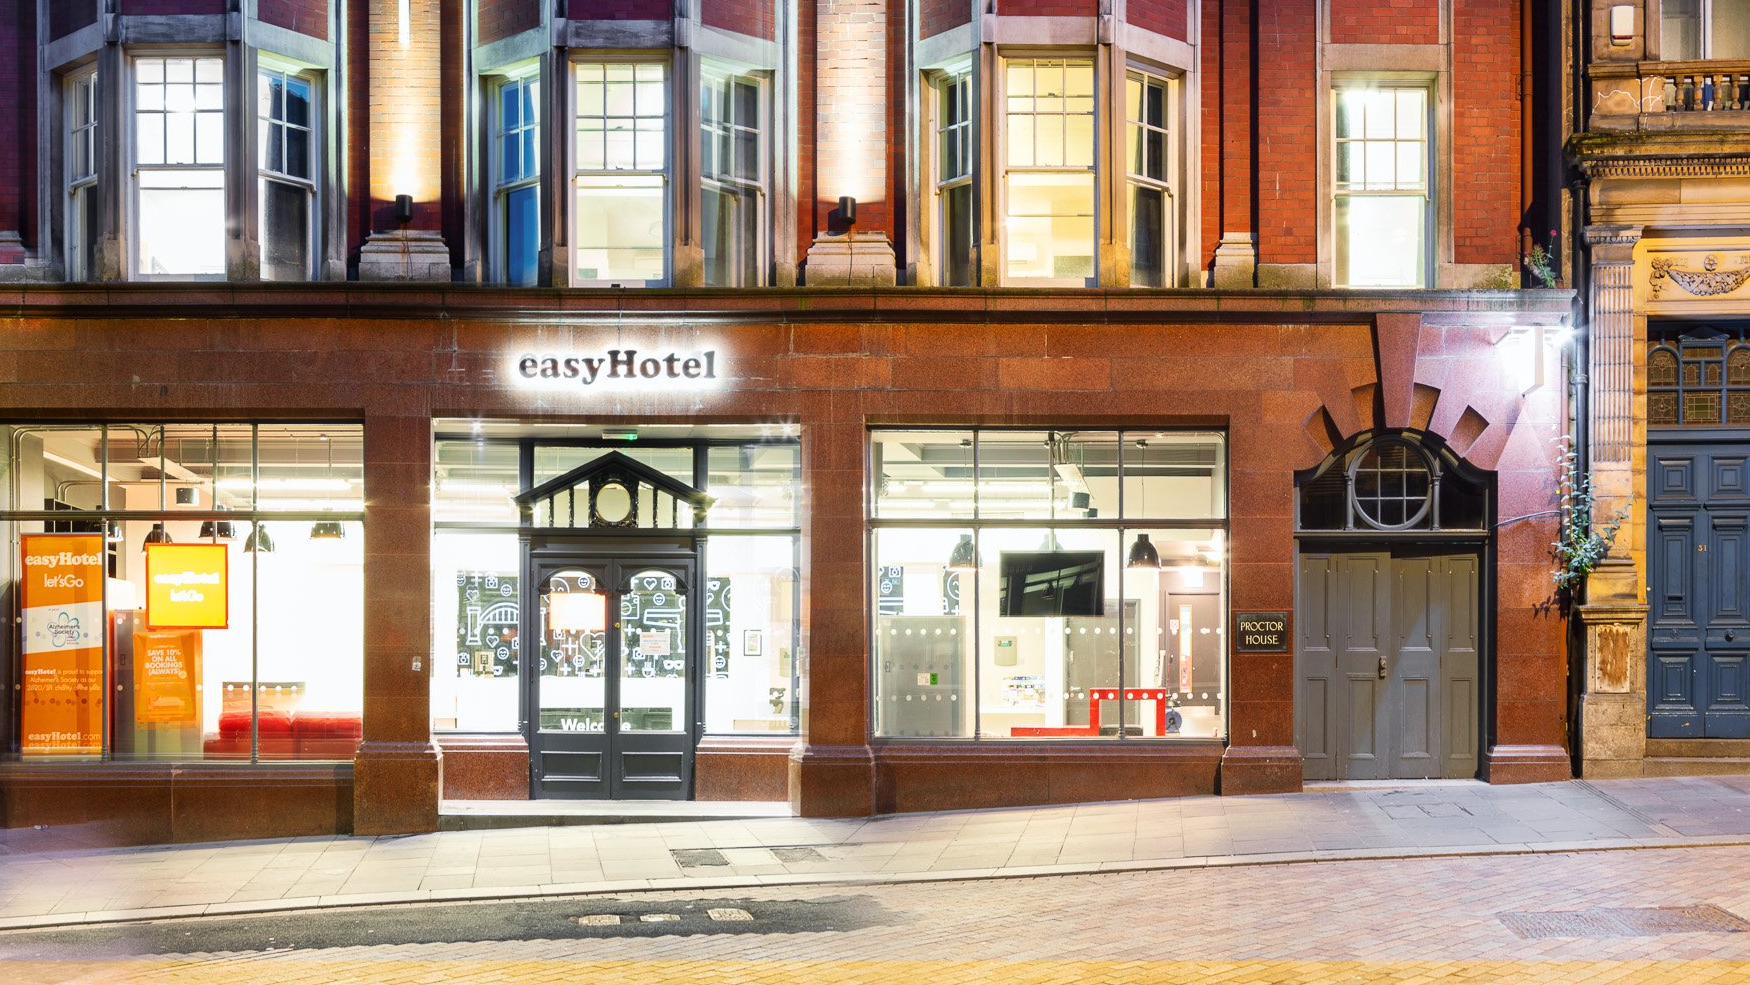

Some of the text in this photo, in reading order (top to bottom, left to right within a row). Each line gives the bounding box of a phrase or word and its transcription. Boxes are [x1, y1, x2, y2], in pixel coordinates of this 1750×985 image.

[518, 349, 717, 385] easyHotel
[24, 552, 102, 569] easyHotel
[1240, 621, 1284, 632] PROCTOR
[1245, 635, 1279, 645] HOUSE
[561, 718, 631, 732] Welcoe
